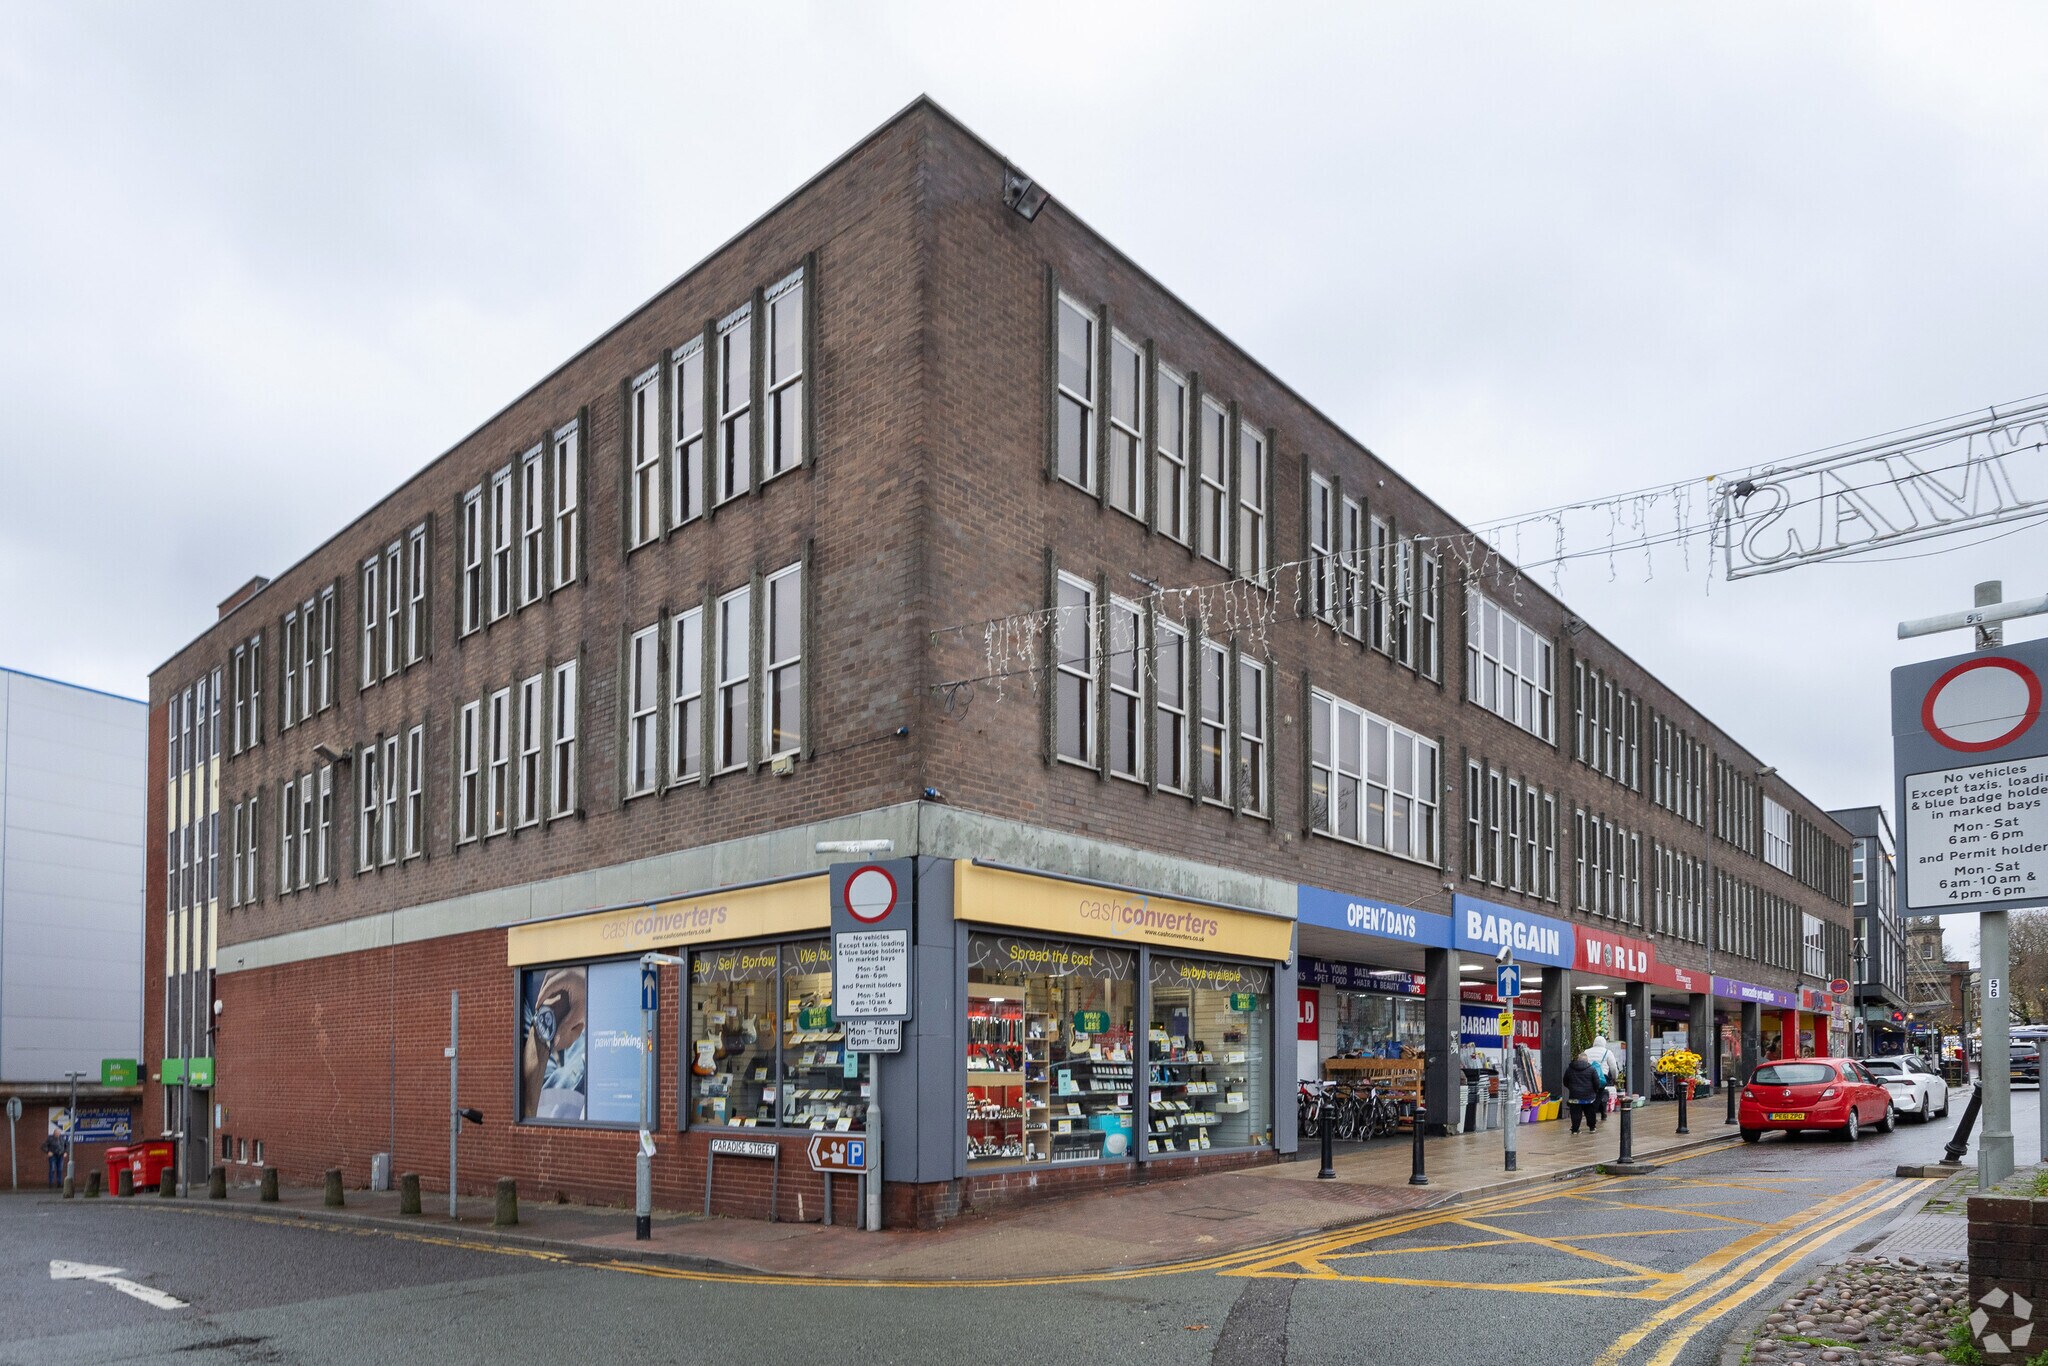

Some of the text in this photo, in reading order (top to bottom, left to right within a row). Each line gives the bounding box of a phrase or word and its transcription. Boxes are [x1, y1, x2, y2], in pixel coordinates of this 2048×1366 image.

[1944, 766, 2027, 783] No vehicles
[1912, 785, 1959, 799] Except
[1911, 802, 1920, 810] &
[1925, 799, 1954, 809] blue
[1960, 792, 2002, 804] badge
[1932, 800, 2041, 820] in marked bays
[1954, 822, 1983, 832] Mon
[1994, 817, 2019, 828] Sat
[1920, 853, 1944, 864] and
[1950, 848, 1996, 860] Permit
[1955, 866, 1984, 876] Mon
[1995, 862, 2020, 872] Sat
[2027, 872, 2036, 881] &
[602, 905, 727, 941] cashconverters
[1080, 899, 1218, 936] cashconverters
[1467, 910, 1559, 955] BARGAIN
[800, 948, 816, 962] We
[1010, 946, 1093, 966] Spread the cost
[693, 955, 776, 975] Buy Sell Borrow
[1180, 965, 1241, 982] laybys available
[1314, 962, 1327, 973] ALL
[1331, 964, 1347, 975] YOUR
[1332, 975, 1347, 985] FOOD
[1380, 981, 1400, 991] BEAUTY
[1408, 984, 1420, 993] TOYS
[874, 1027, 898, 1035] Thurs
[1461, 1015, 1499, 1035] BARGAIN
[851, 1037, 869, 1046] 6pm
[877, 1037, 895, 1045] 6am
[713, 1140, 776, 1155] PARADISE STREET
[851, 1144, 862, 1163] P
